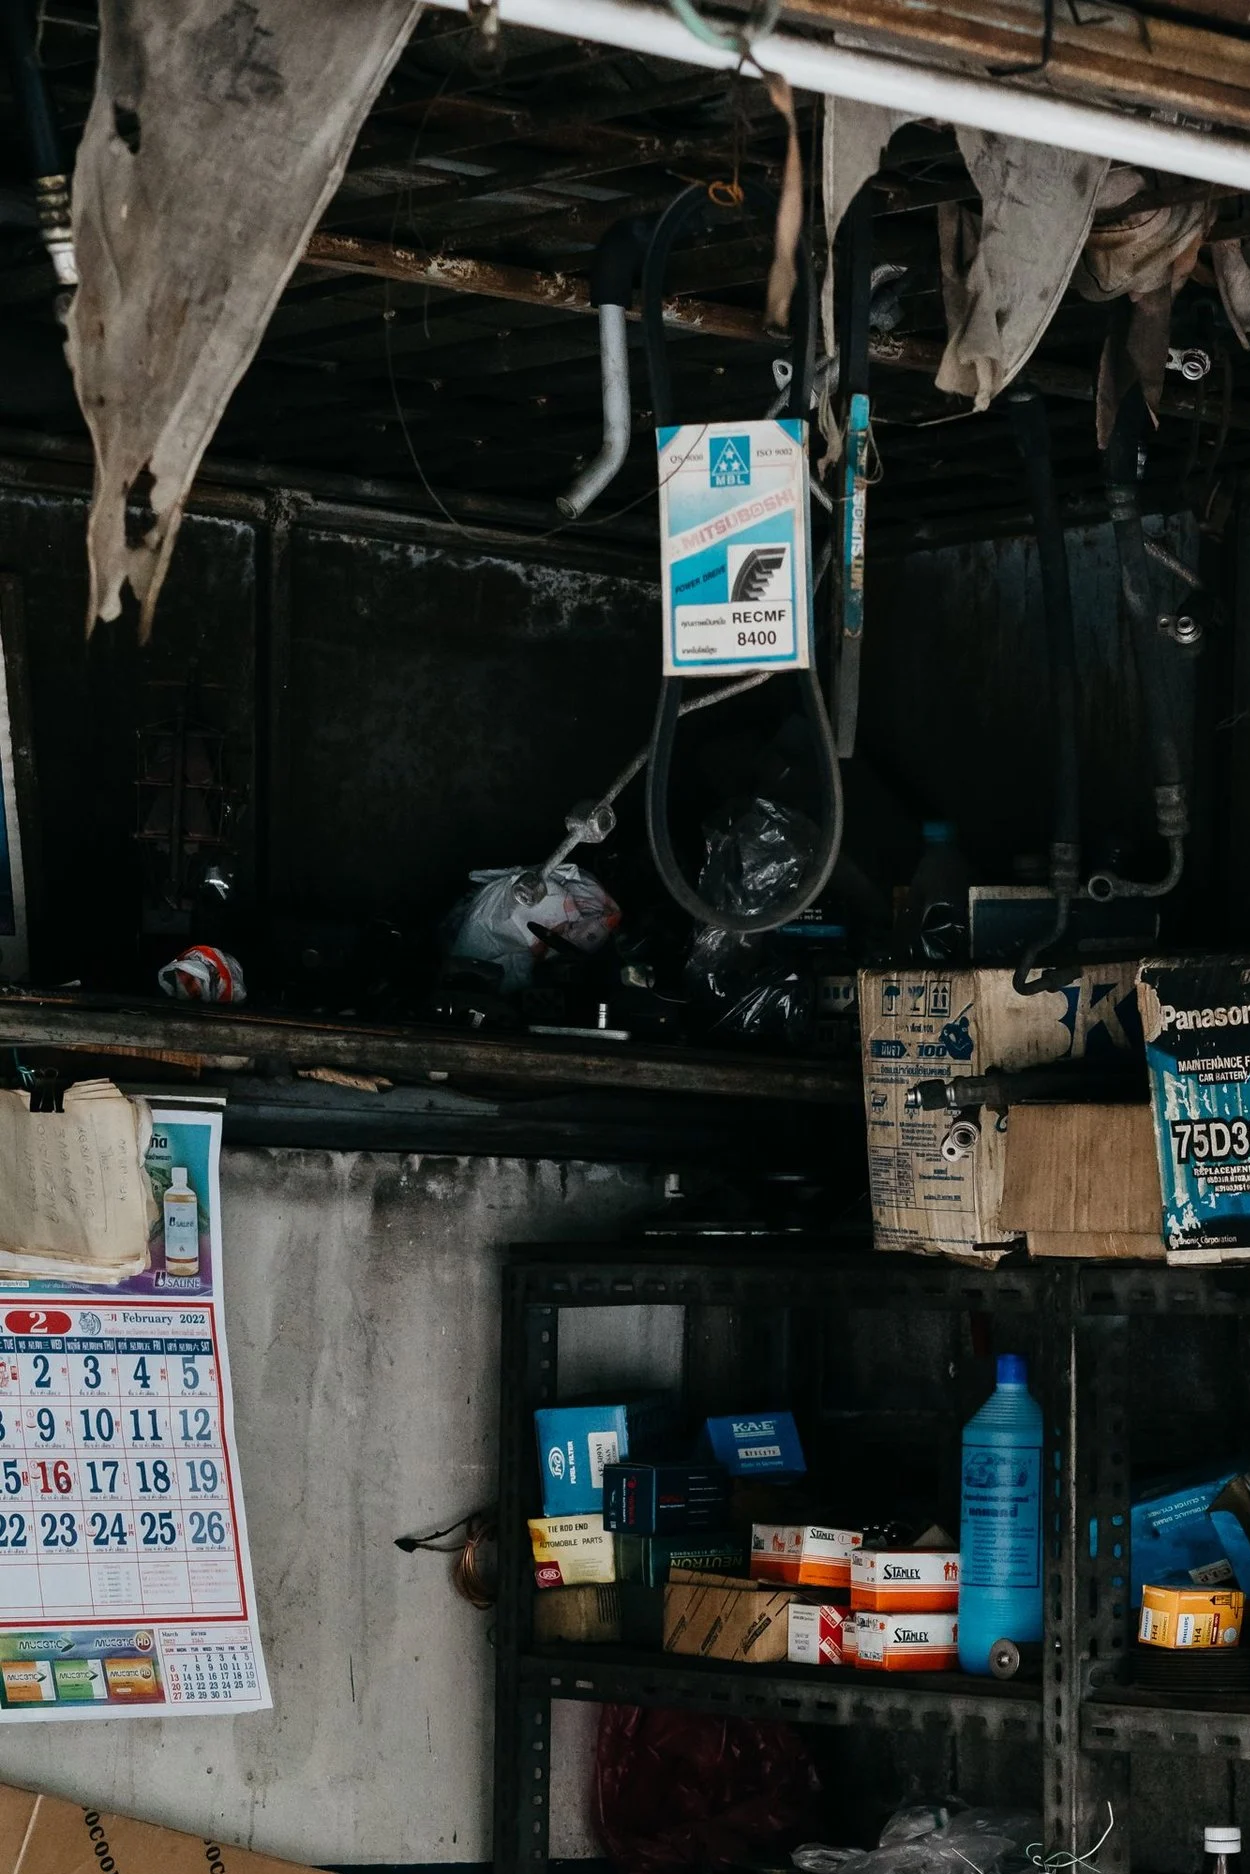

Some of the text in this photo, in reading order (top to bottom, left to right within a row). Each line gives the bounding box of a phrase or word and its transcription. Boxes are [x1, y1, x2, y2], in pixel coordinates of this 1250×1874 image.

[716, 474, 745, 485] MBL
[681, 487, 794, 549] MITSUBOSHI
[732, 610, 786, 624] RECMF
[737, 632, 776, 646] 8400
[1178, 1056, 1244, 1071] MAINTENANCE
[1199, 1070, 1248, 1082] CAR BATTERY
[167, 1278, 200, 1289] SALINE
[29, 1311, 48, 1333] 2
[123, 1312, 206, 1325] February 2022
[33, 1355, 200, 1389] 2 3 4 5
[37, 1408, 212, 1442] 9 10 11 12
[567, 1441, 577, 1484] FUEL FILTER
[37, 1460, 218, 1494] 16 17 18 19
[41, 1511, 225, 1547] 23 24 25 26
[547, 1522, 588, 1533] TIE ROD END
[810, 1528, 835, 1542] STANLEY
[540, 1536, 603, 1549] AUTOMOBILE PARTS
[882, 1563, 921, 1580] STANLEY
[893, 1627, 929, 1644] STANLEY
[1151, 1624, 1158, 1640] H4
[1194, 1628, 1202, 1643] H4
